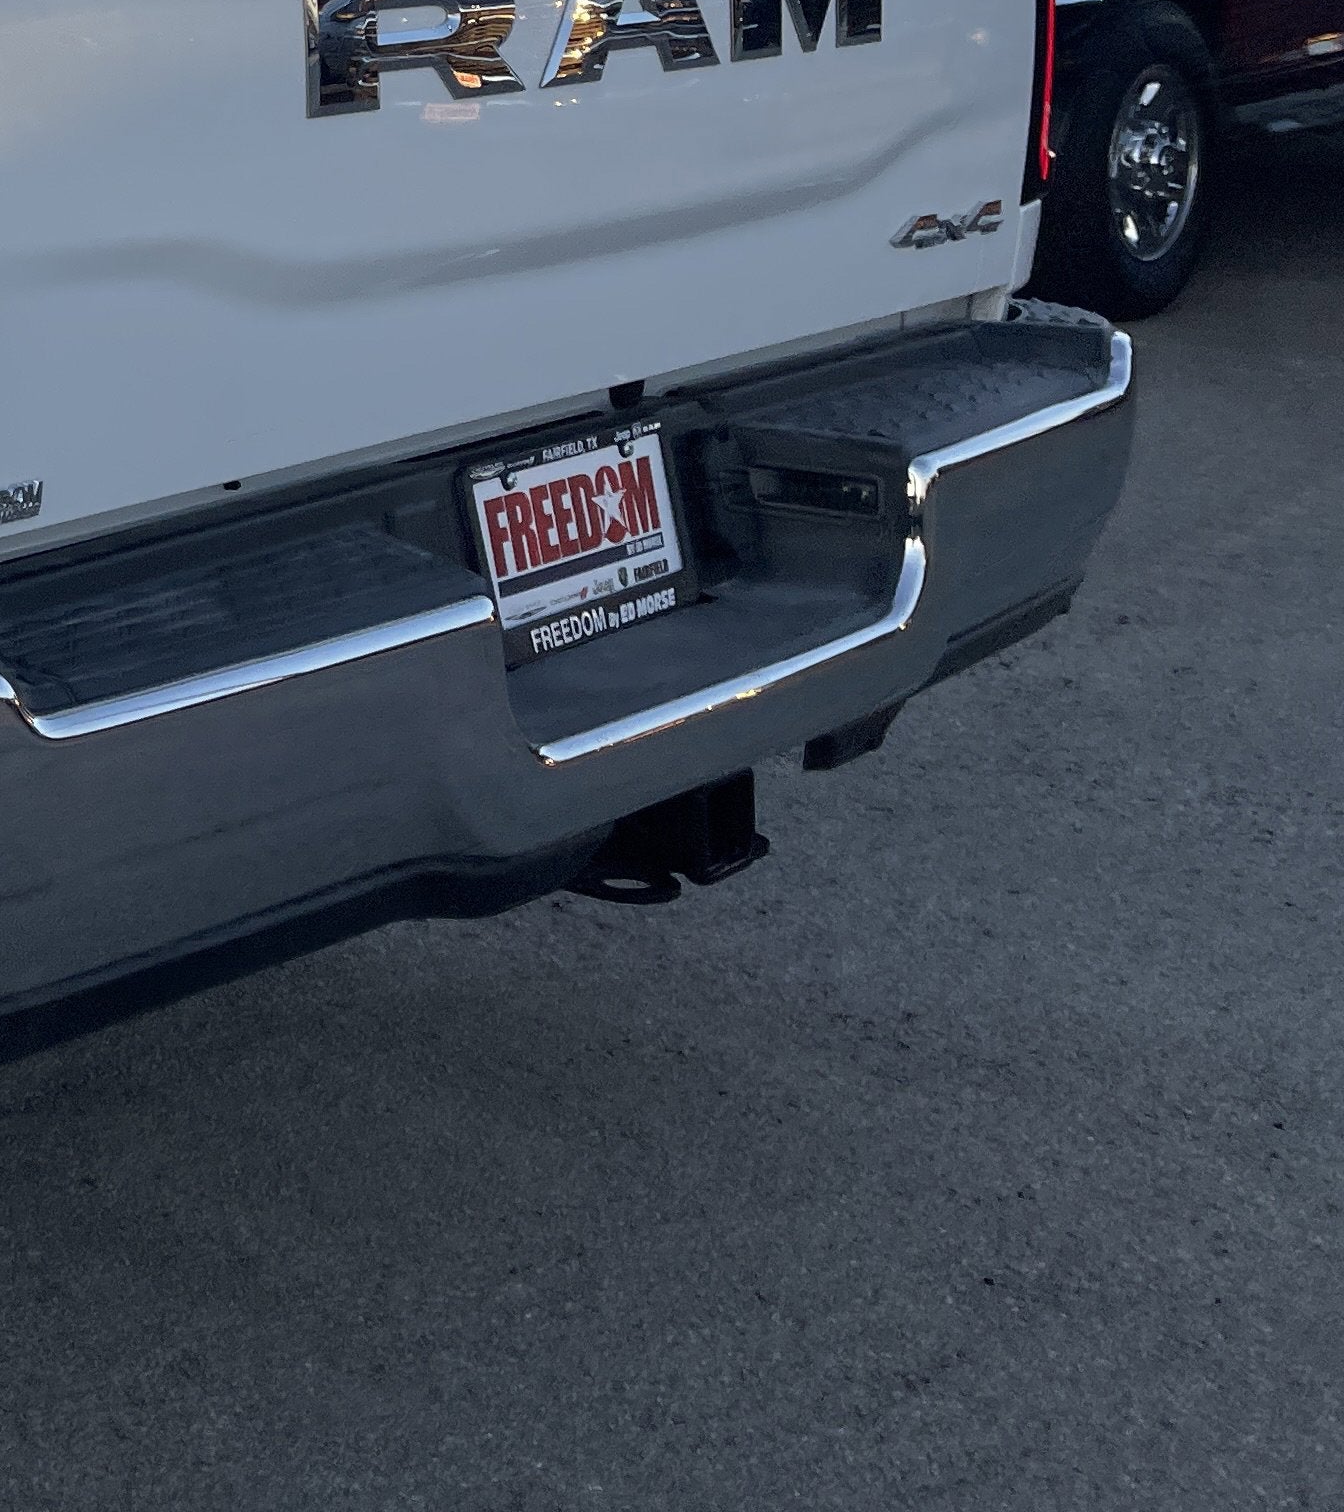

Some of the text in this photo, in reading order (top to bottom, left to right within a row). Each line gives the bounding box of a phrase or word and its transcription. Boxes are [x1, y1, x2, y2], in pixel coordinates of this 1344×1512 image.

[586, 436, 598, 451] TX
[483, 456, 661, 578] FREEDOM
[530, 606, 606, 653] FREEDOM
[619, 602, 636, 624] ED
[636, 588, 676, 618] MORSE
